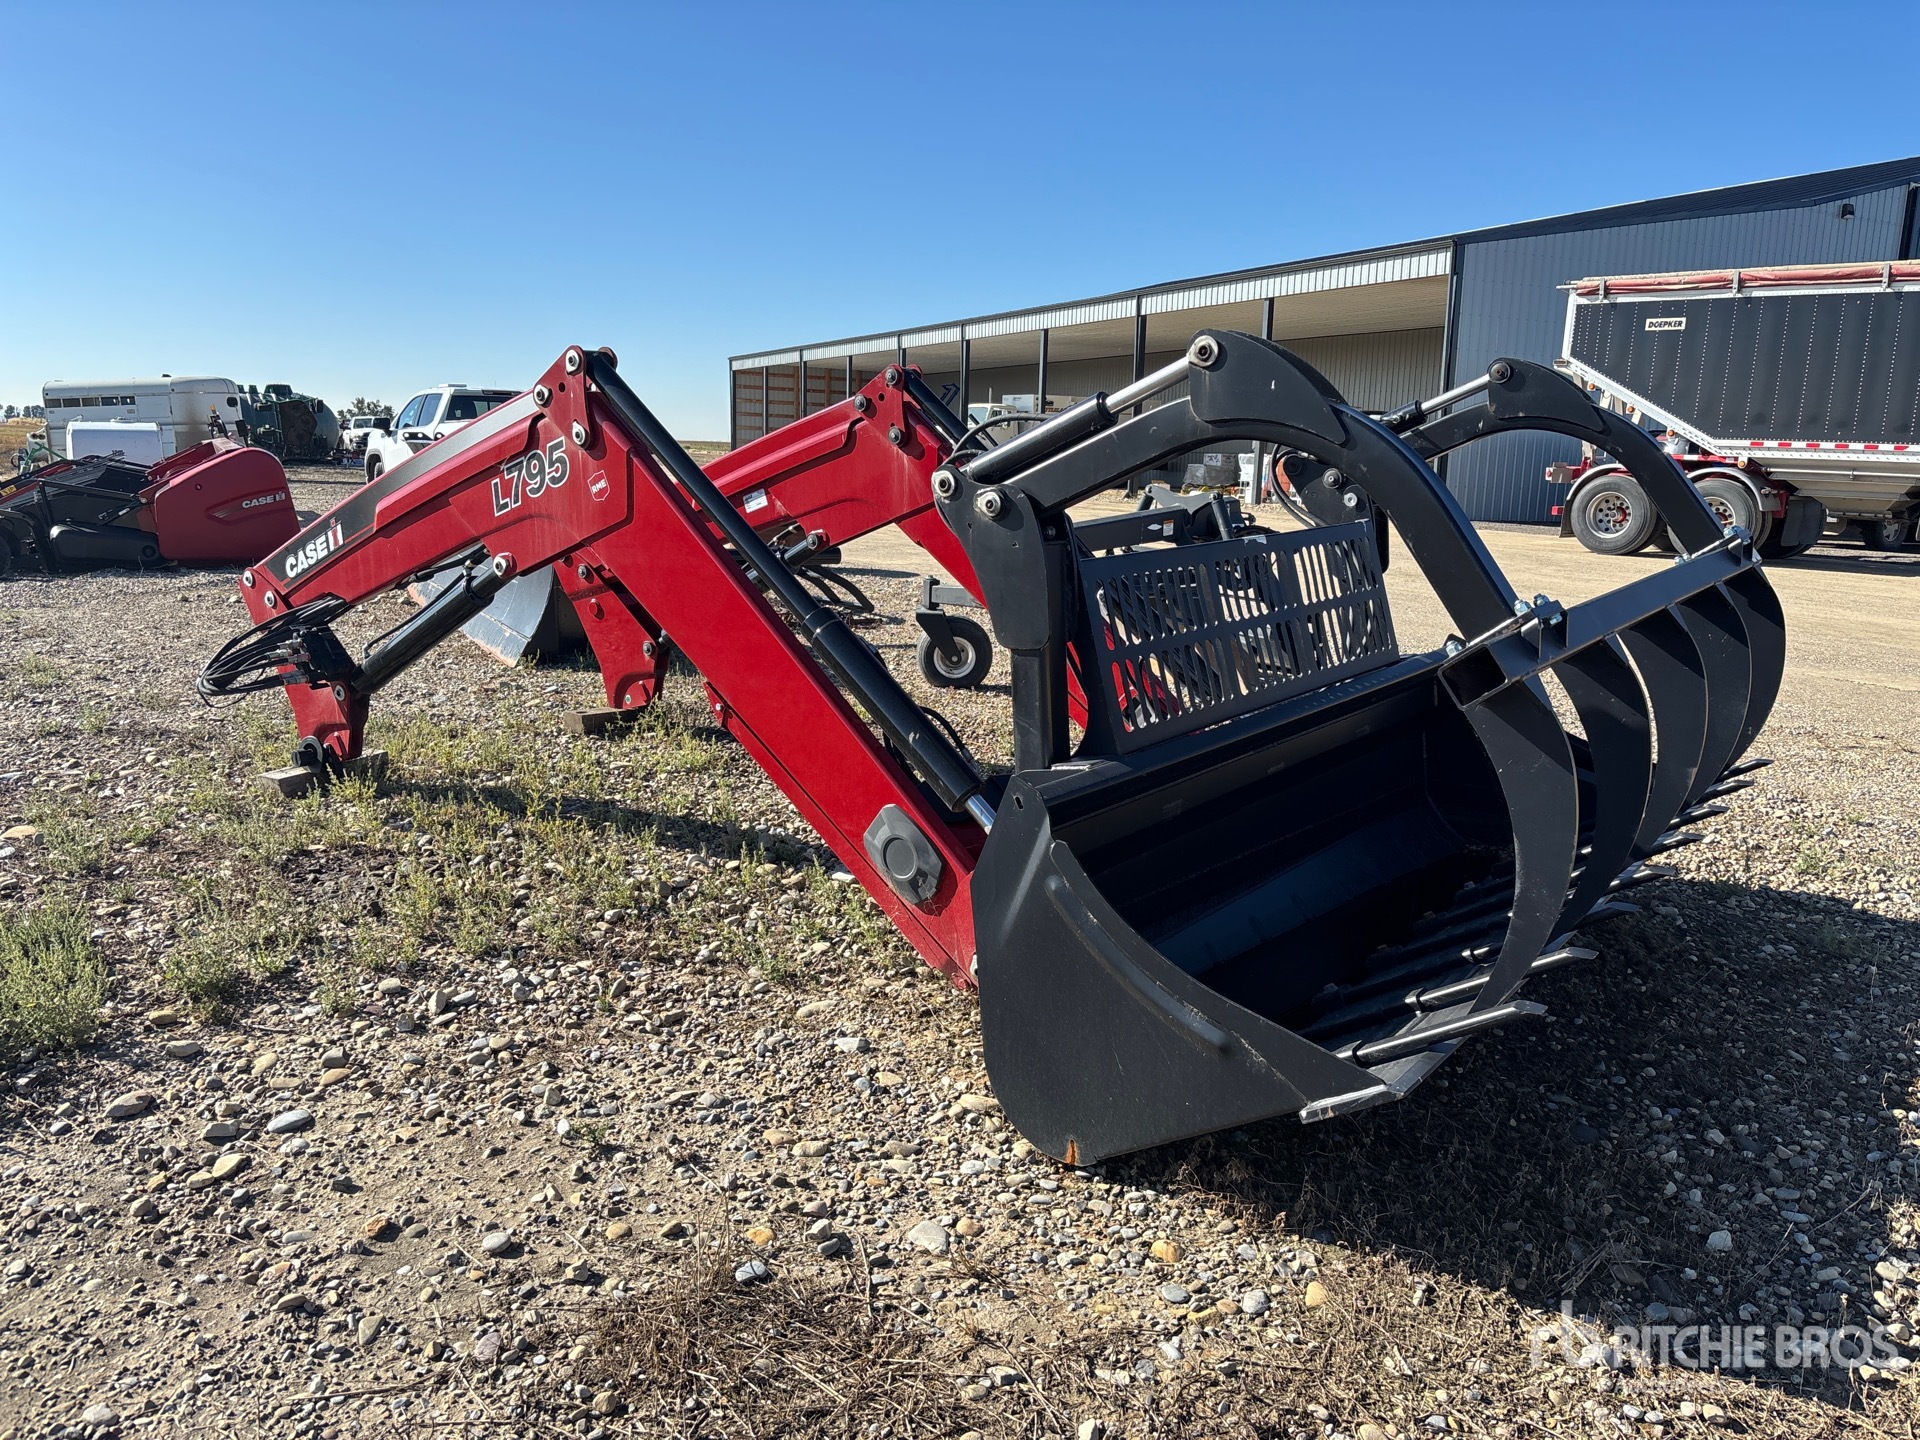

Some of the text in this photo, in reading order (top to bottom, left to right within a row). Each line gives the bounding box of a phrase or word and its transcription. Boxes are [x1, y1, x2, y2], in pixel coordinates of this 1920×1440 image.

[1648, 320, 1683, 328] DOEPKER
[491, 436, 570, 517] L795
[591, 478, 607, 494] RME
[241, 494, 275, 509] CASE
[285, 533, 329, 578] CASE
